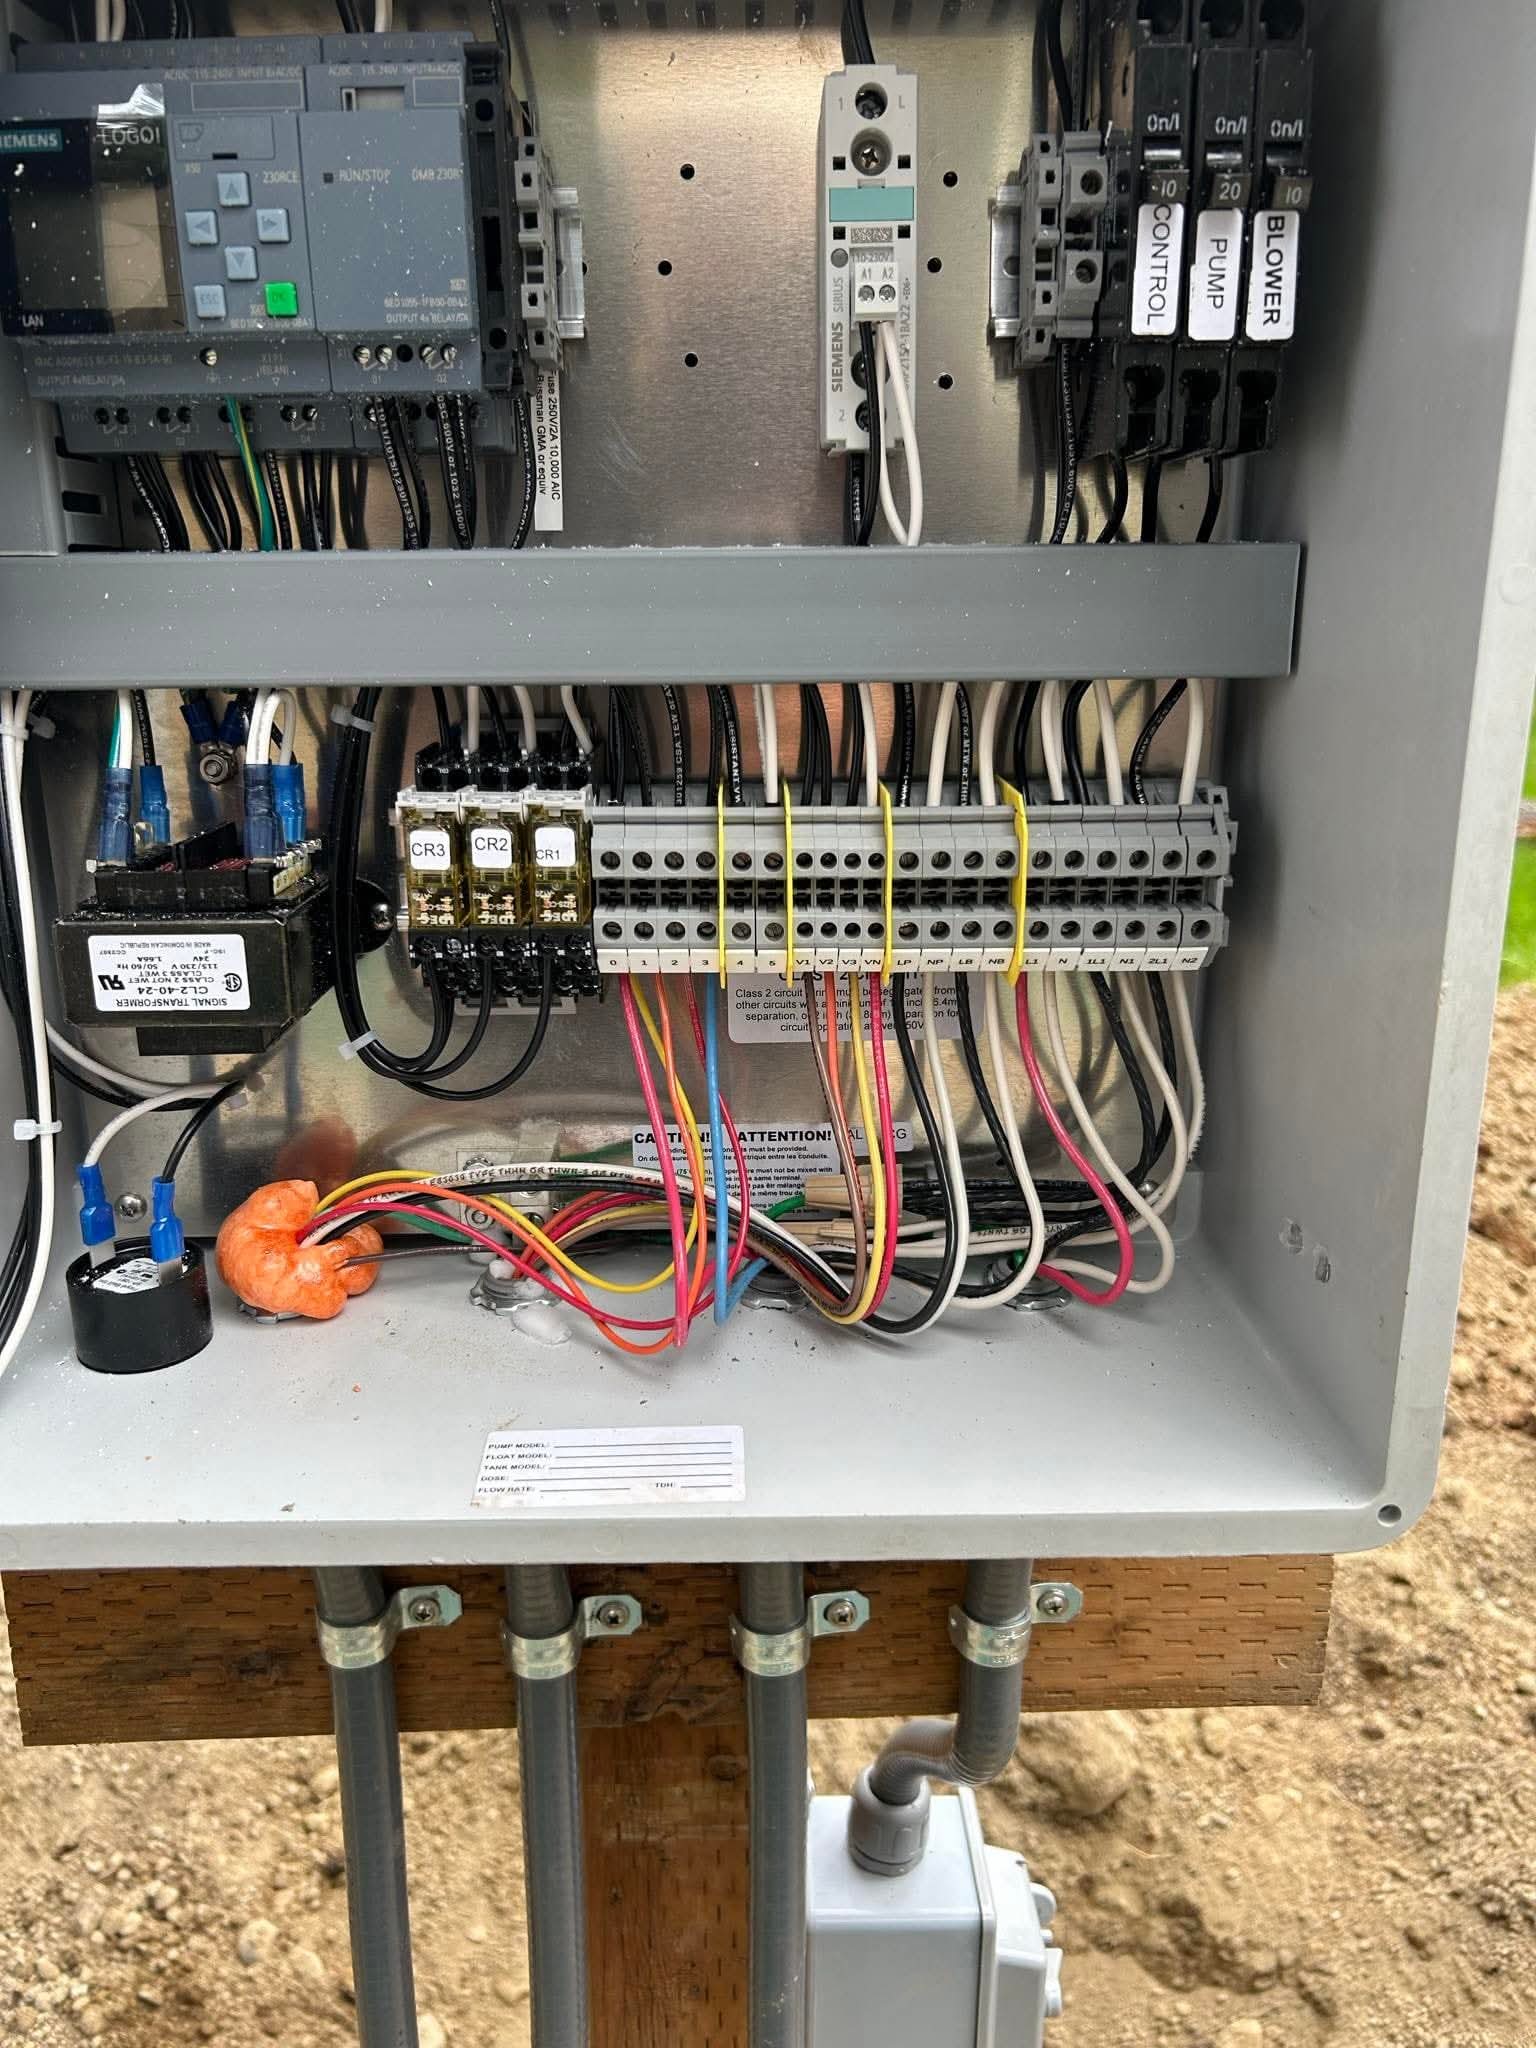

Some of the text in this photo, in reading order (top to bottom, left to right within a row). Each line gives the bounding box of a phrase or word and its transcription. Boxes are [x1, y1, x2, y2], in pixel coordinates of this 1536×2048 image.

[0, 133, 58, 149] IEMENS
[1160, 179, 1177, 198] 10
[1219, 180, 1241, 200] 20
[1286, 186, 1302, 204] 10
[882, 265, 895, 279] A2
[1147, 204, 1172, 327] CONTROL
[1262, 215, 1286, 326] BLOWER
[861, 267, 872, 280] A1
[1206, 238, 1228, 310] PUMP
[22, 316, 44, 328] LAN
[831, 321, 844, 393] SIEMENS
[548, 397, 559, 442] 250V/2A
[537, 424, 547, 452] GMA
[538, 454, 545, 465] or
[549, 443, 560, 480] 10,000
[449, 471, 461, 501] 1032
[536, 467, 546, 496] equiv
[551, 481, 561, 501] AIC
[671, 714, 681, 737] TEW
[674, 741, 683, 764] CSA
[727, 720, 739, 781] RESISTANT
[962, 739, 970, 765] MTW
[411, 842, 446, 857] CR3
[474, 836, 509, 851] CR2
[535, 849, 560, 860] CR1
[119, 941, 150, 949] REPUBLIC
[819, 958, 834, 966] V2
[842, 958, 857, 966] V3
[864, 958, 881, 966] VN
[958, 958, 973, 966] LB
[988, 958, 1005, 966] NB
[1181, 957, 1199, 965] N2
[182, 976, 215, 984] CLASS
[137, 986, 209, 995] CL2-40-24
[735, 986, 956, 998] Class 2 circuit from
[116, 998, 228, 1007] SIGNAL TRANSFORMER
[735, 1001, 760, 1010] other
[762, 1000, 797, 1009] circuits
[745, 1012, 799, 1021] separation,
[780, 1023, 809, 1031] circuit
[738, 1130, 832, 1142] ATTENTION!
[777, 1145, 809, 1153] provided.
[469, 1169, 495, 1180] TYPE
[498, 1166, 526, 1176] THHN
[529, 1166, 545, 1174] OR
[778, 1189, 793, 1197] trou
